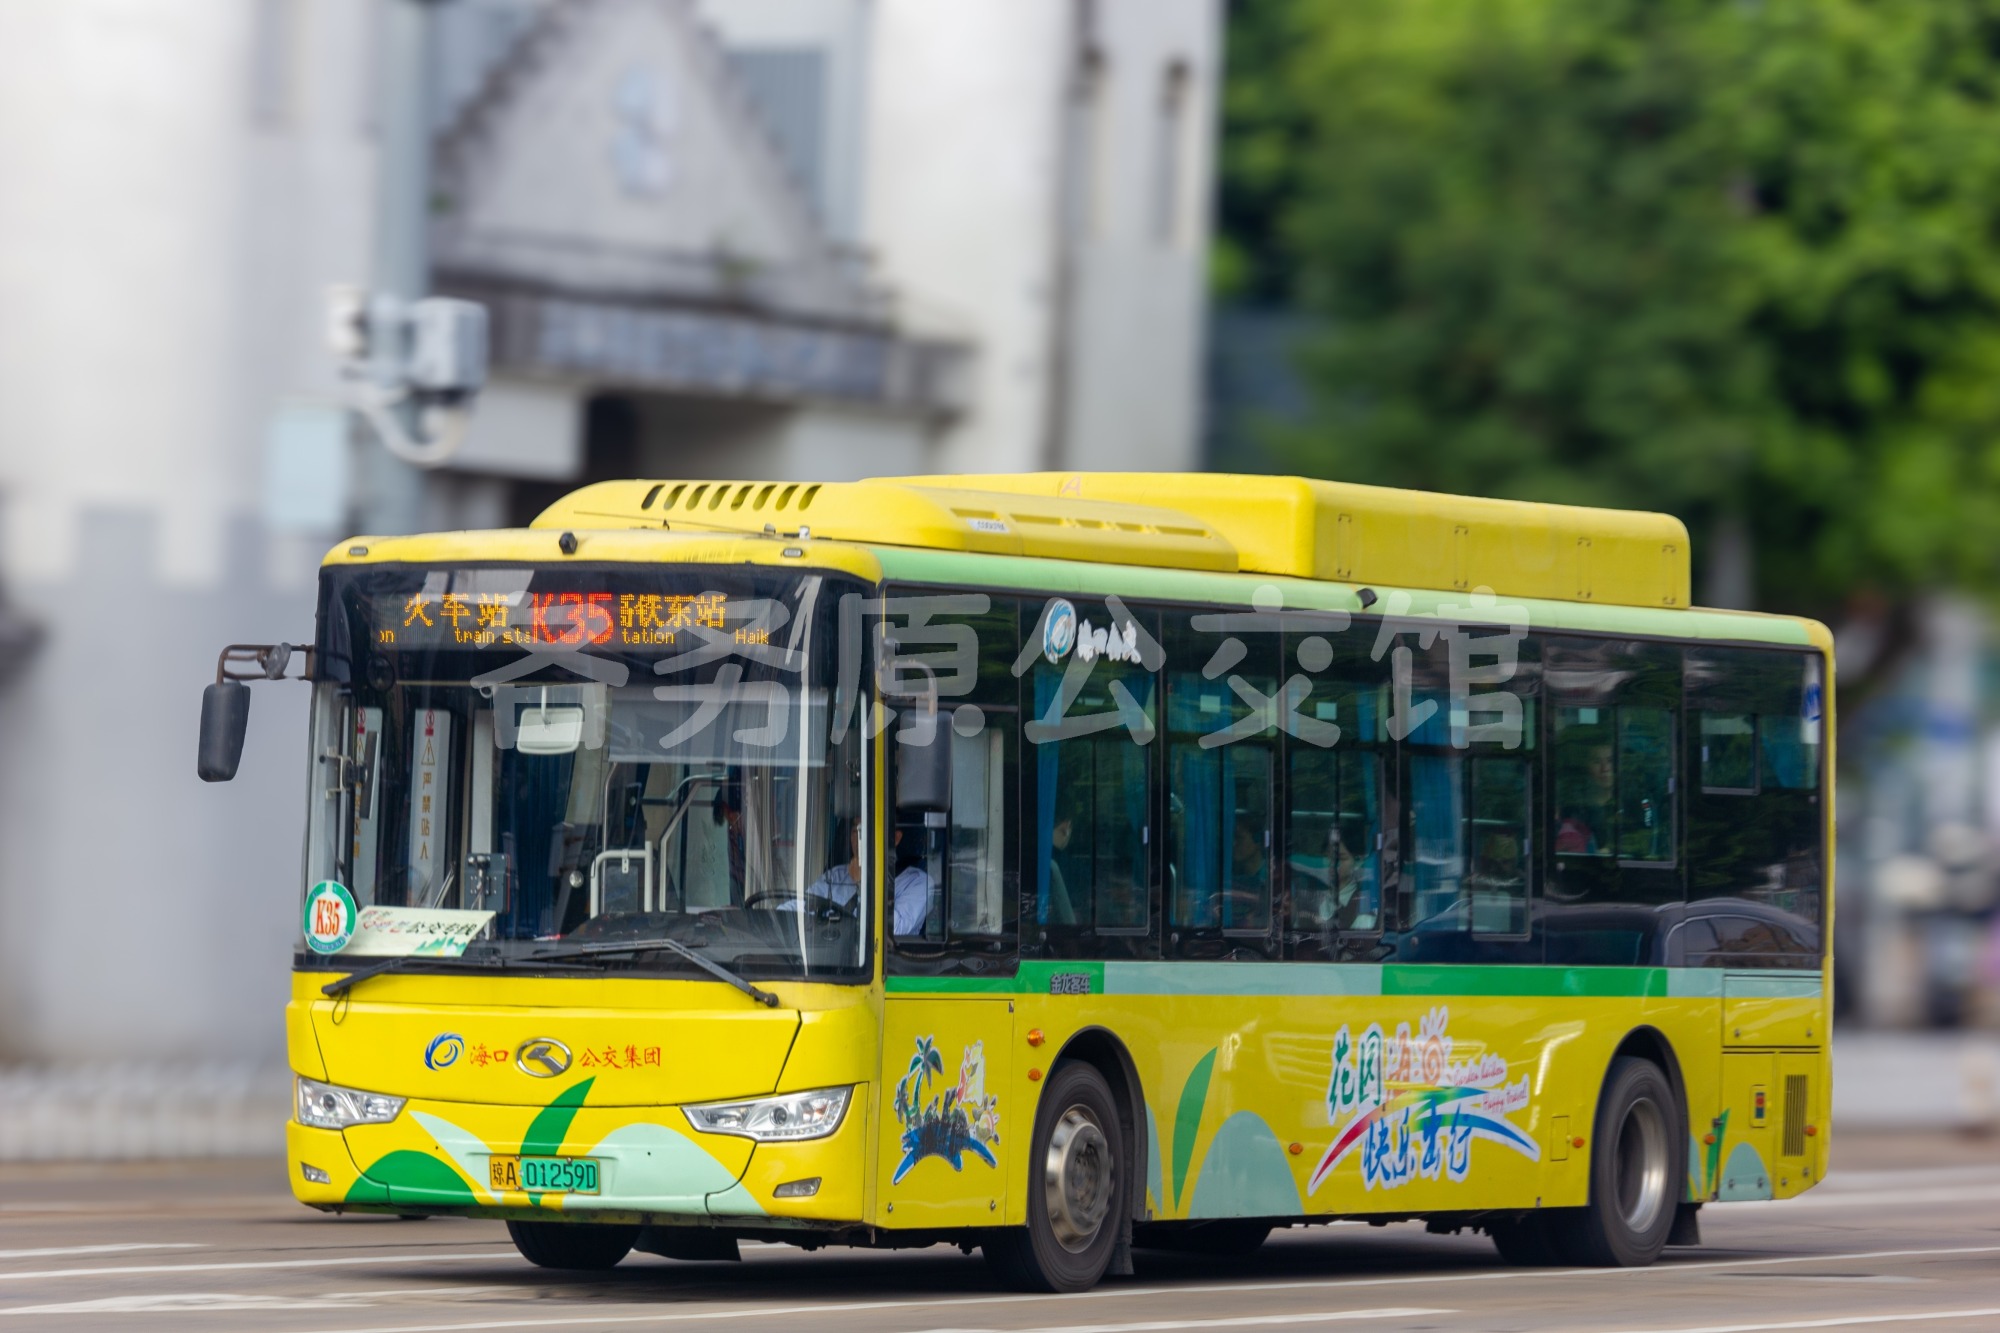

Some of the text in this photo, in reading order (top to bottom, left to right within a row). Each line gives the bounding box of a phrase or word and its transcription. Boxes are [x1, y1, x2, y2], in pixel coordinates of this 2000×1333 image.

[404, 593, 509, 627] 火车站
[532, 593, 615, 644] K35
[455, 627, 495, 643] train
[621, 628, 674, 644] tation
[315, 899, 341, 936] K35
[1050, 973, 1090, 995] 金龙客车
[469, 1043, 661, 1069] 海口 公交集团
